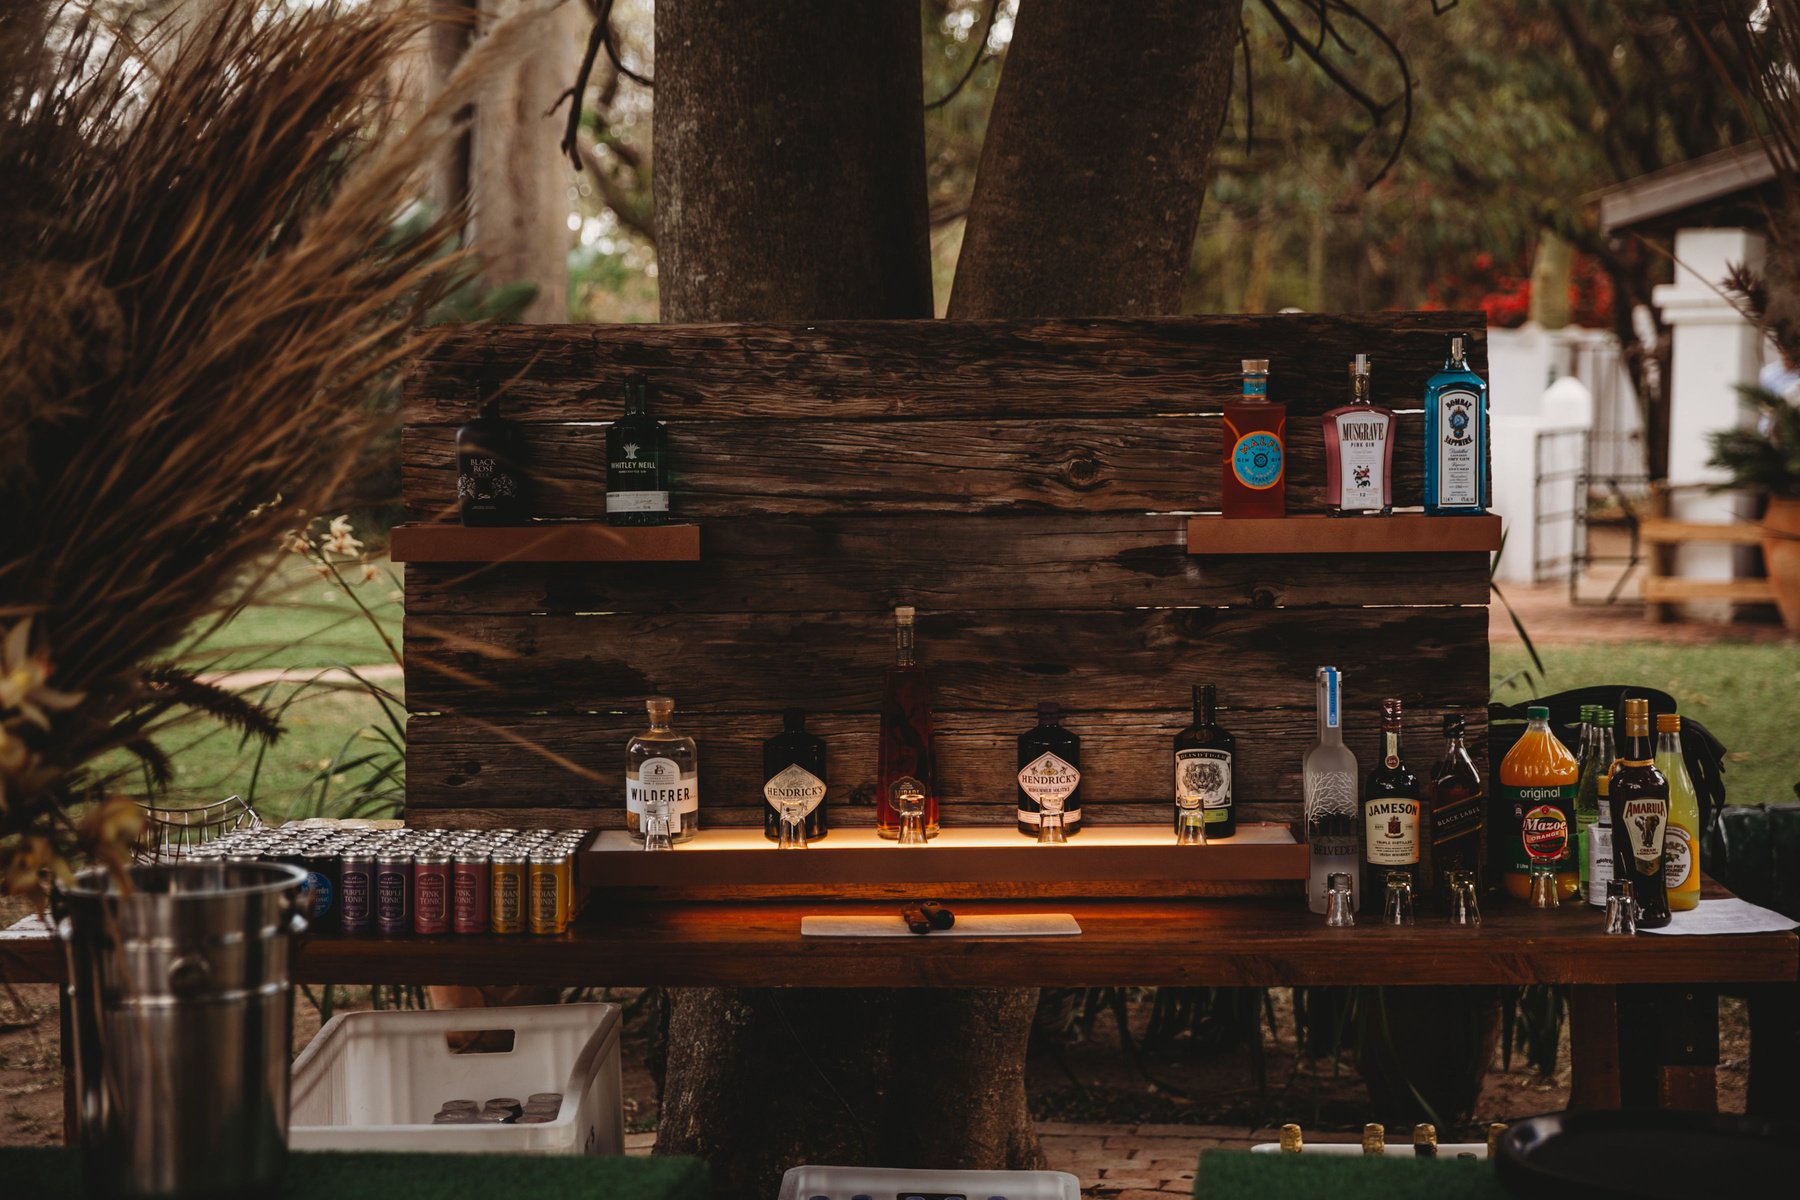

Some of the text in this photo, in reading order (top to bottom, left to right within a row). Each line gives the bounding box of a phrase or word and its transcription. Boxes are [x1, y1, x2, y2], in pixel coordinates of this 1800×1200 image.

[1445, 398, 1472, 410] BOMBAY
[1342, 422, 1384, 441] MUSGRAVE
[1444, 435, 1473, 446] SAPPHIRE
[470, 458, 496, 466] BLACK
[638, 461, 656, 469] NEILL
[1021, 773, 1077, 785] HENDRICK'S
[630, 788, 690, 802] WILDERER
[767, 785, 823, 797] HENDRICK'S
[1520, 787, 1560, 801] original
[1369, 803, 1417, 817] JAMESON
[1625, 801, 1666, 818] AMARULA
[1437, 807, 1480, 827] BLACK LABEL
[1525, 818, 1567, 831] Mazoe
[1530, 831, 1560, 842] ORANGE
[381, 896, 401, 904] TONIC
[495, 897, 517, 905] TONIC
[533, 897, 555, 905] TONIC
